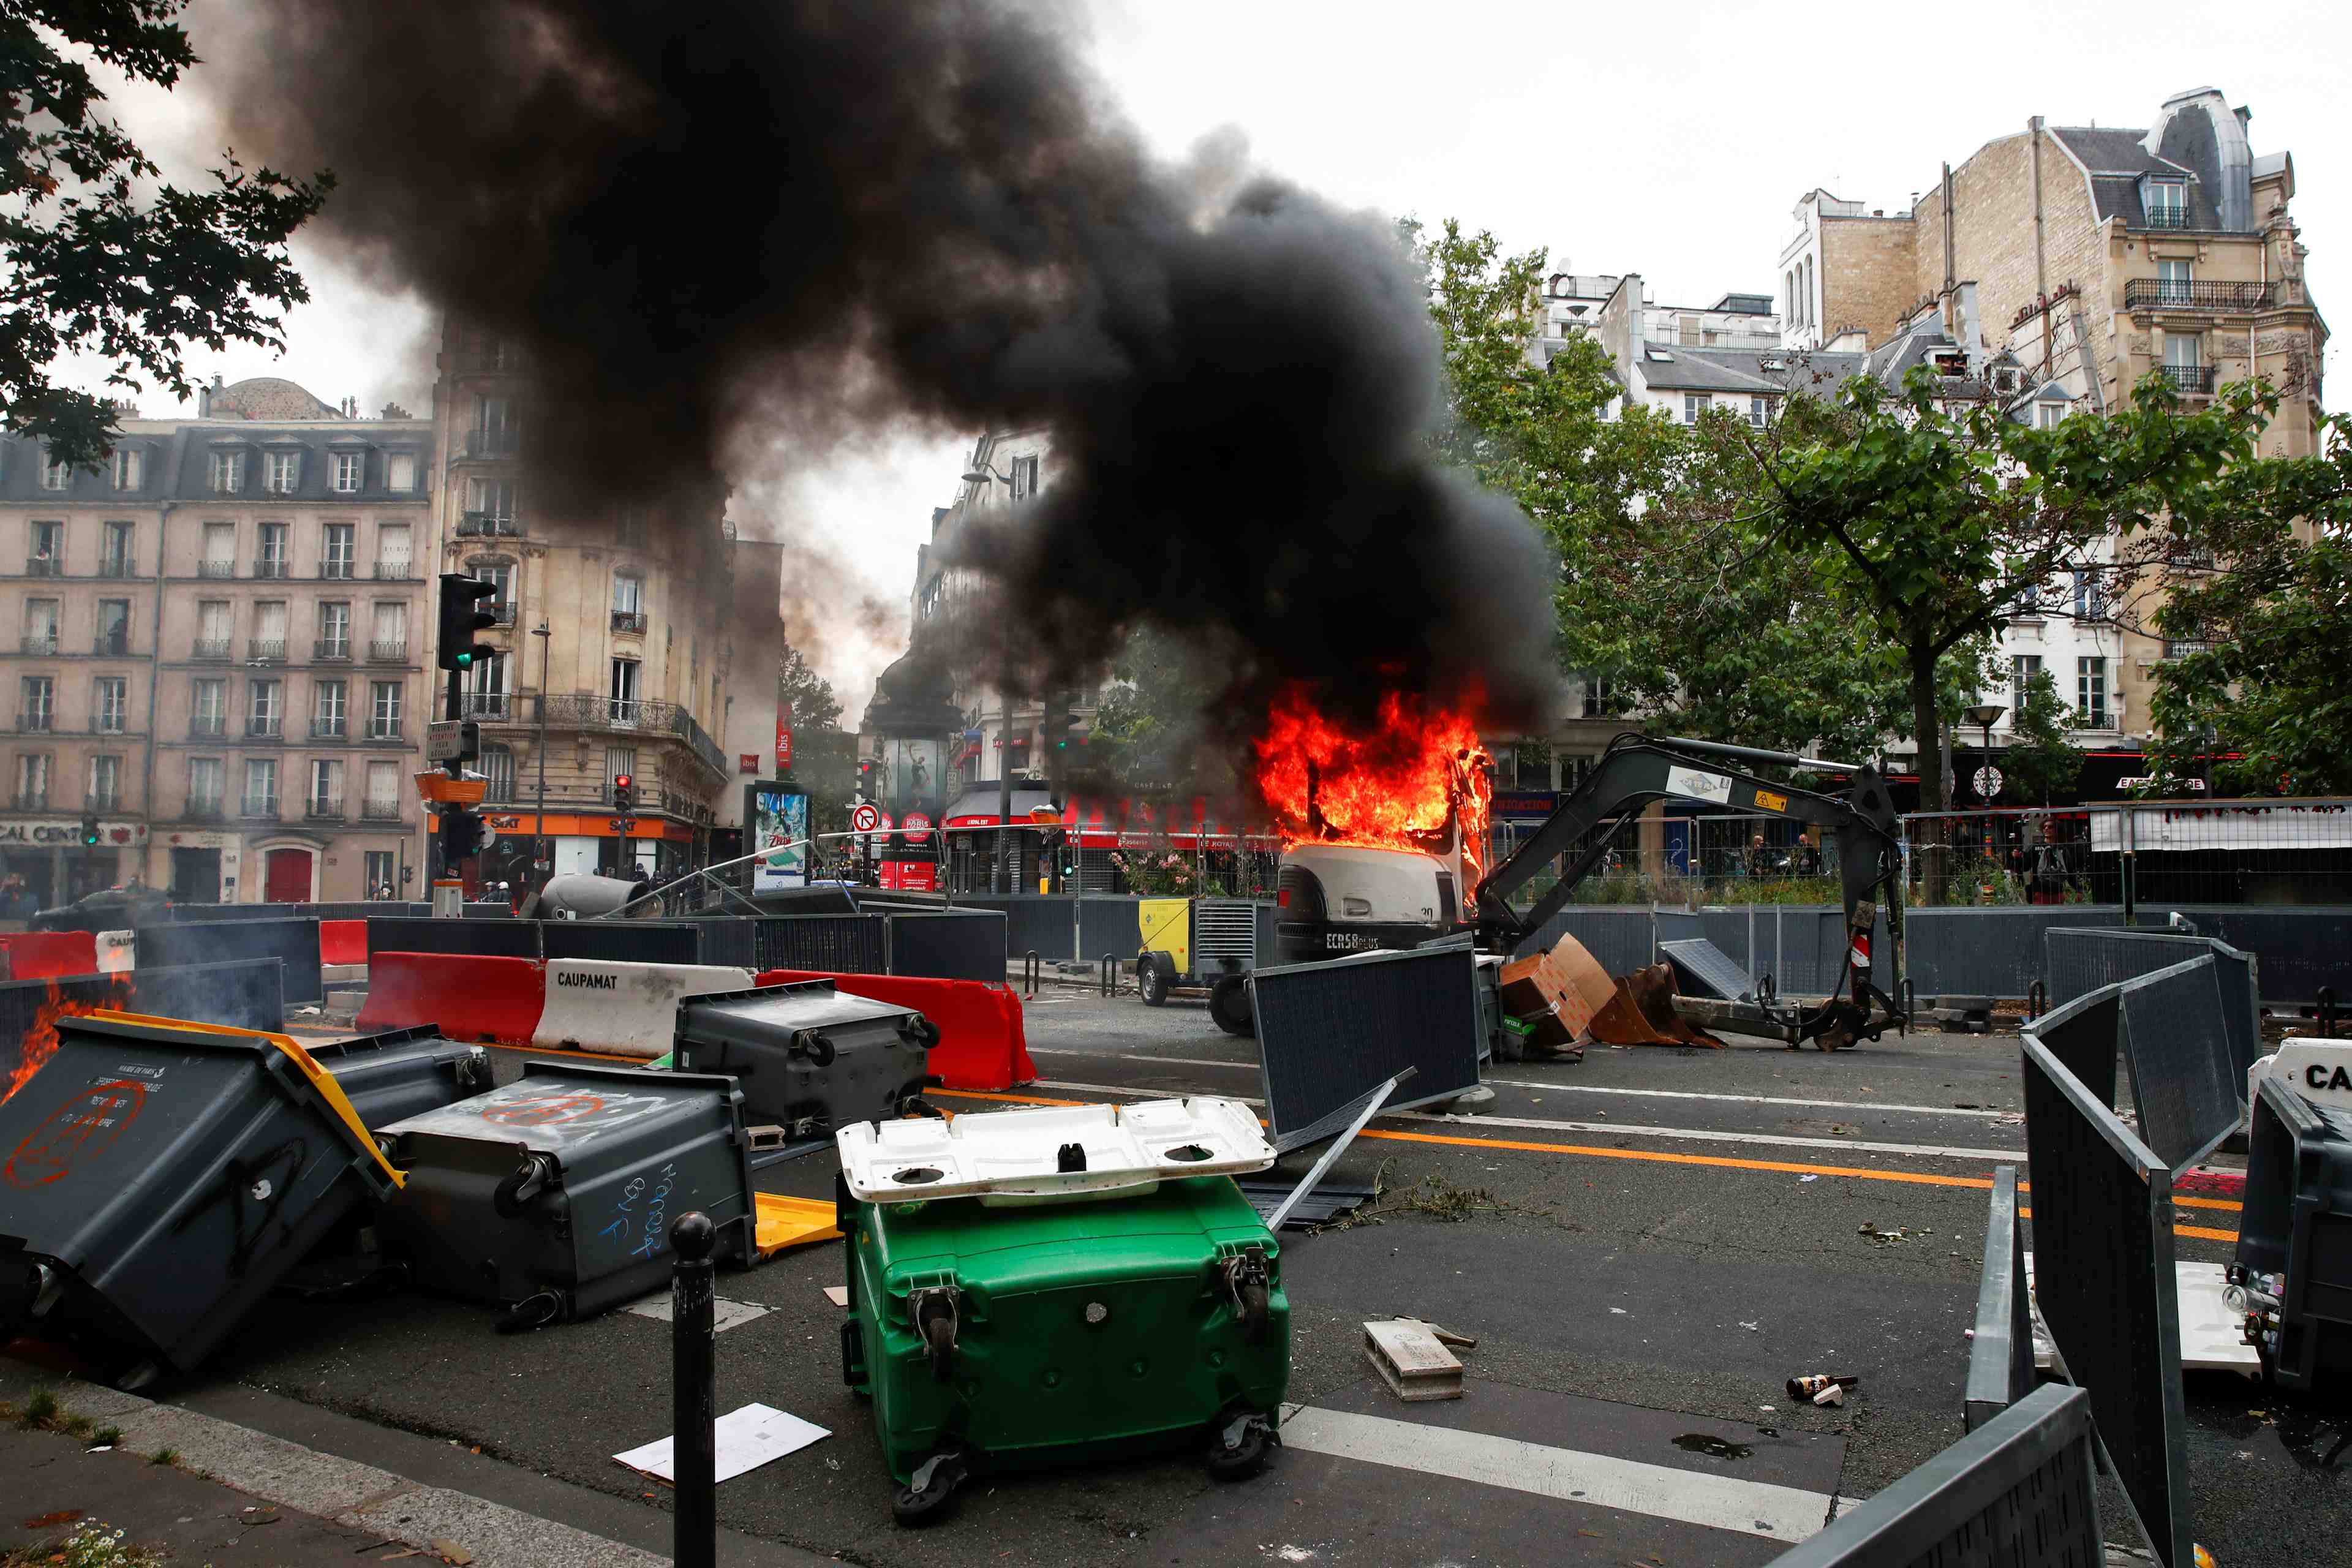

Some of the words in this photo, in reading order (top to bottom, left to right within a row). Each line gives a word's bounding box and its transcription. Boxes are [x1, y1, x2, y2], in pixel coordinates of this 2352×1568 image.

[778, 735, 788, 752] ibis
[1326, 933, 1358, 949] ECR58
[558, 972, 617, 989] CAUPAMAT
